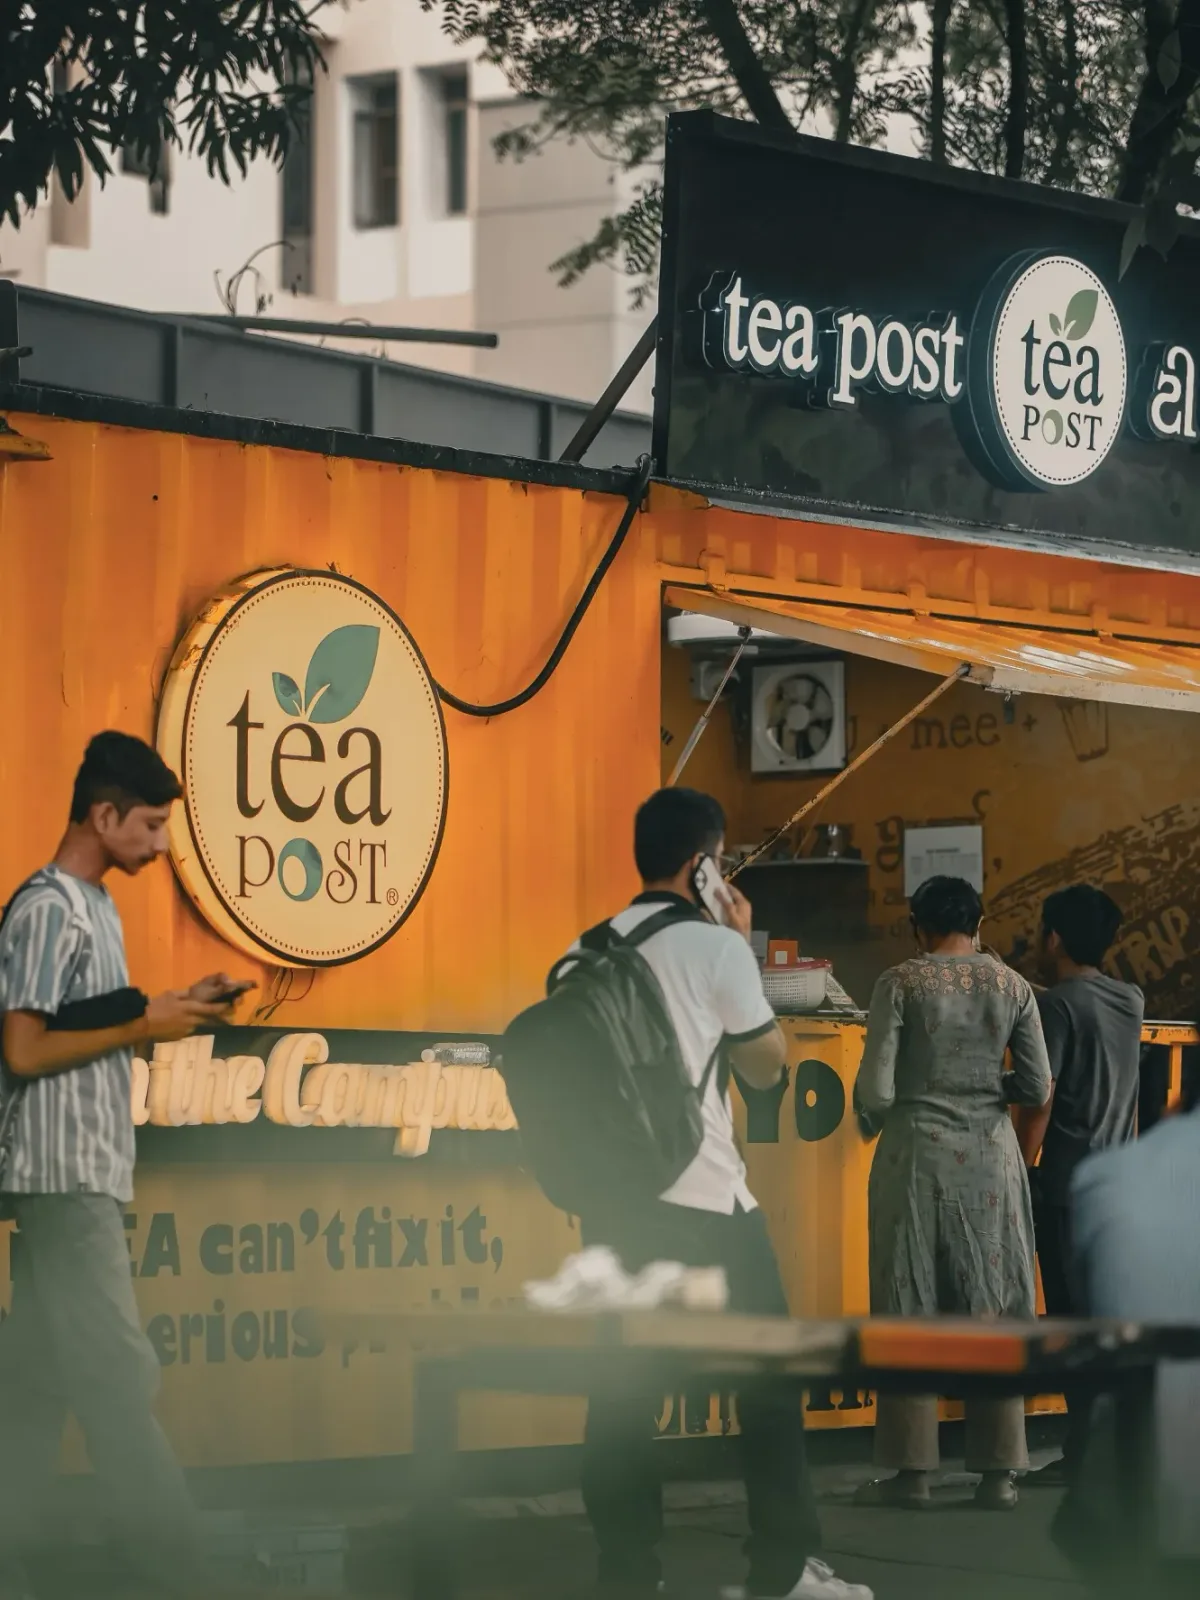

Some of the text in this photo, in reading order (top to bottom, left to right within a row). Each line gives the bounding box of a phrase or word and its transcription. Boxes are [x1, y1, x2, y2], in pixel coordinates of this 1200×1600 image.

[724, 276, 965, 405] tea post
[1020, 319, 1104, 407] tea
[1020, 403, 1103, 452] POST
[226, 688, 392, 827] tea
[353, 1205, 430, 1269] fix
[438, 1203, 504, 1274] it,
[147, 1299, 326, 1367] erious
